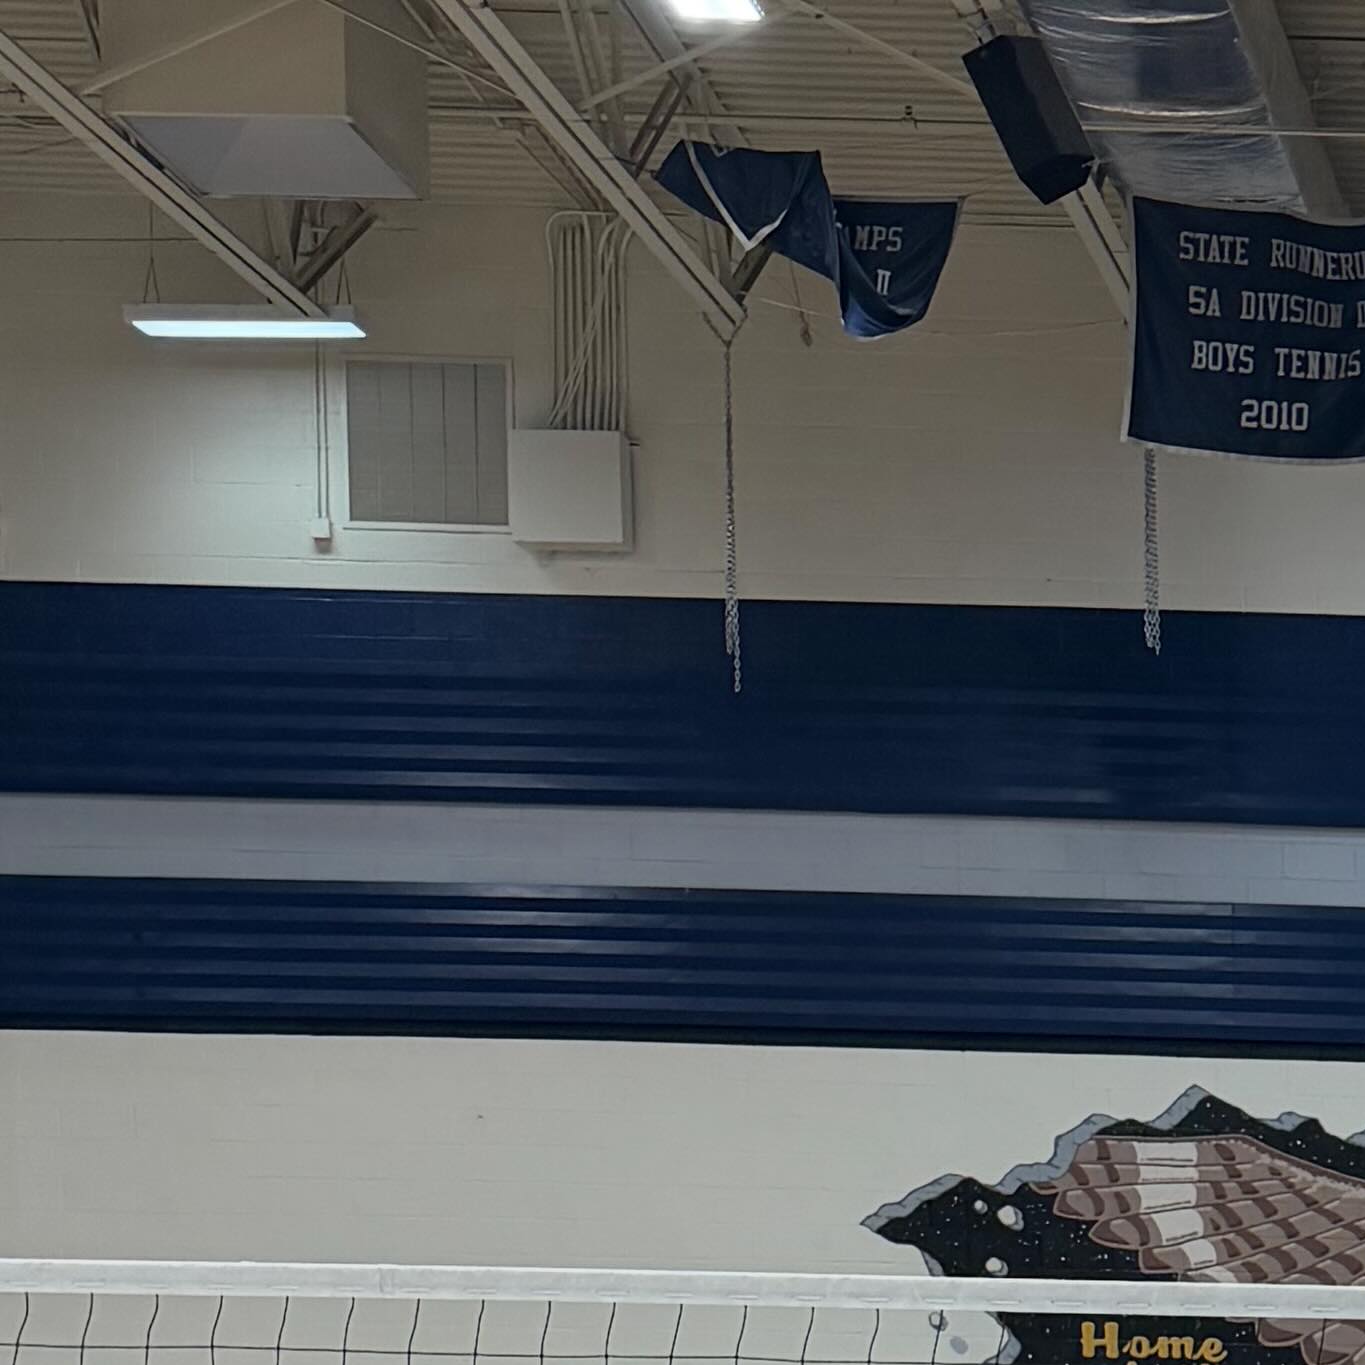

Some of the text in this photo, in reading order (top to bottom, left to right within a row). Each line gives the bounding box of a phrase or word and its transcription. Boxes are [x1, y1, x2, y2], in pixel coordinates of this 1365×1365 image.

[1179, 231, 1249, 265] STATE
[1188, 285, 1221, 317] 5A
[1239, 290, 1344, 328] DIVISION
[1191, 340, 1361, 380] BOYS TENNIS
[1240, 399, 1309, 431] 2010
[1080, 1321, 1228, 1362] Home
